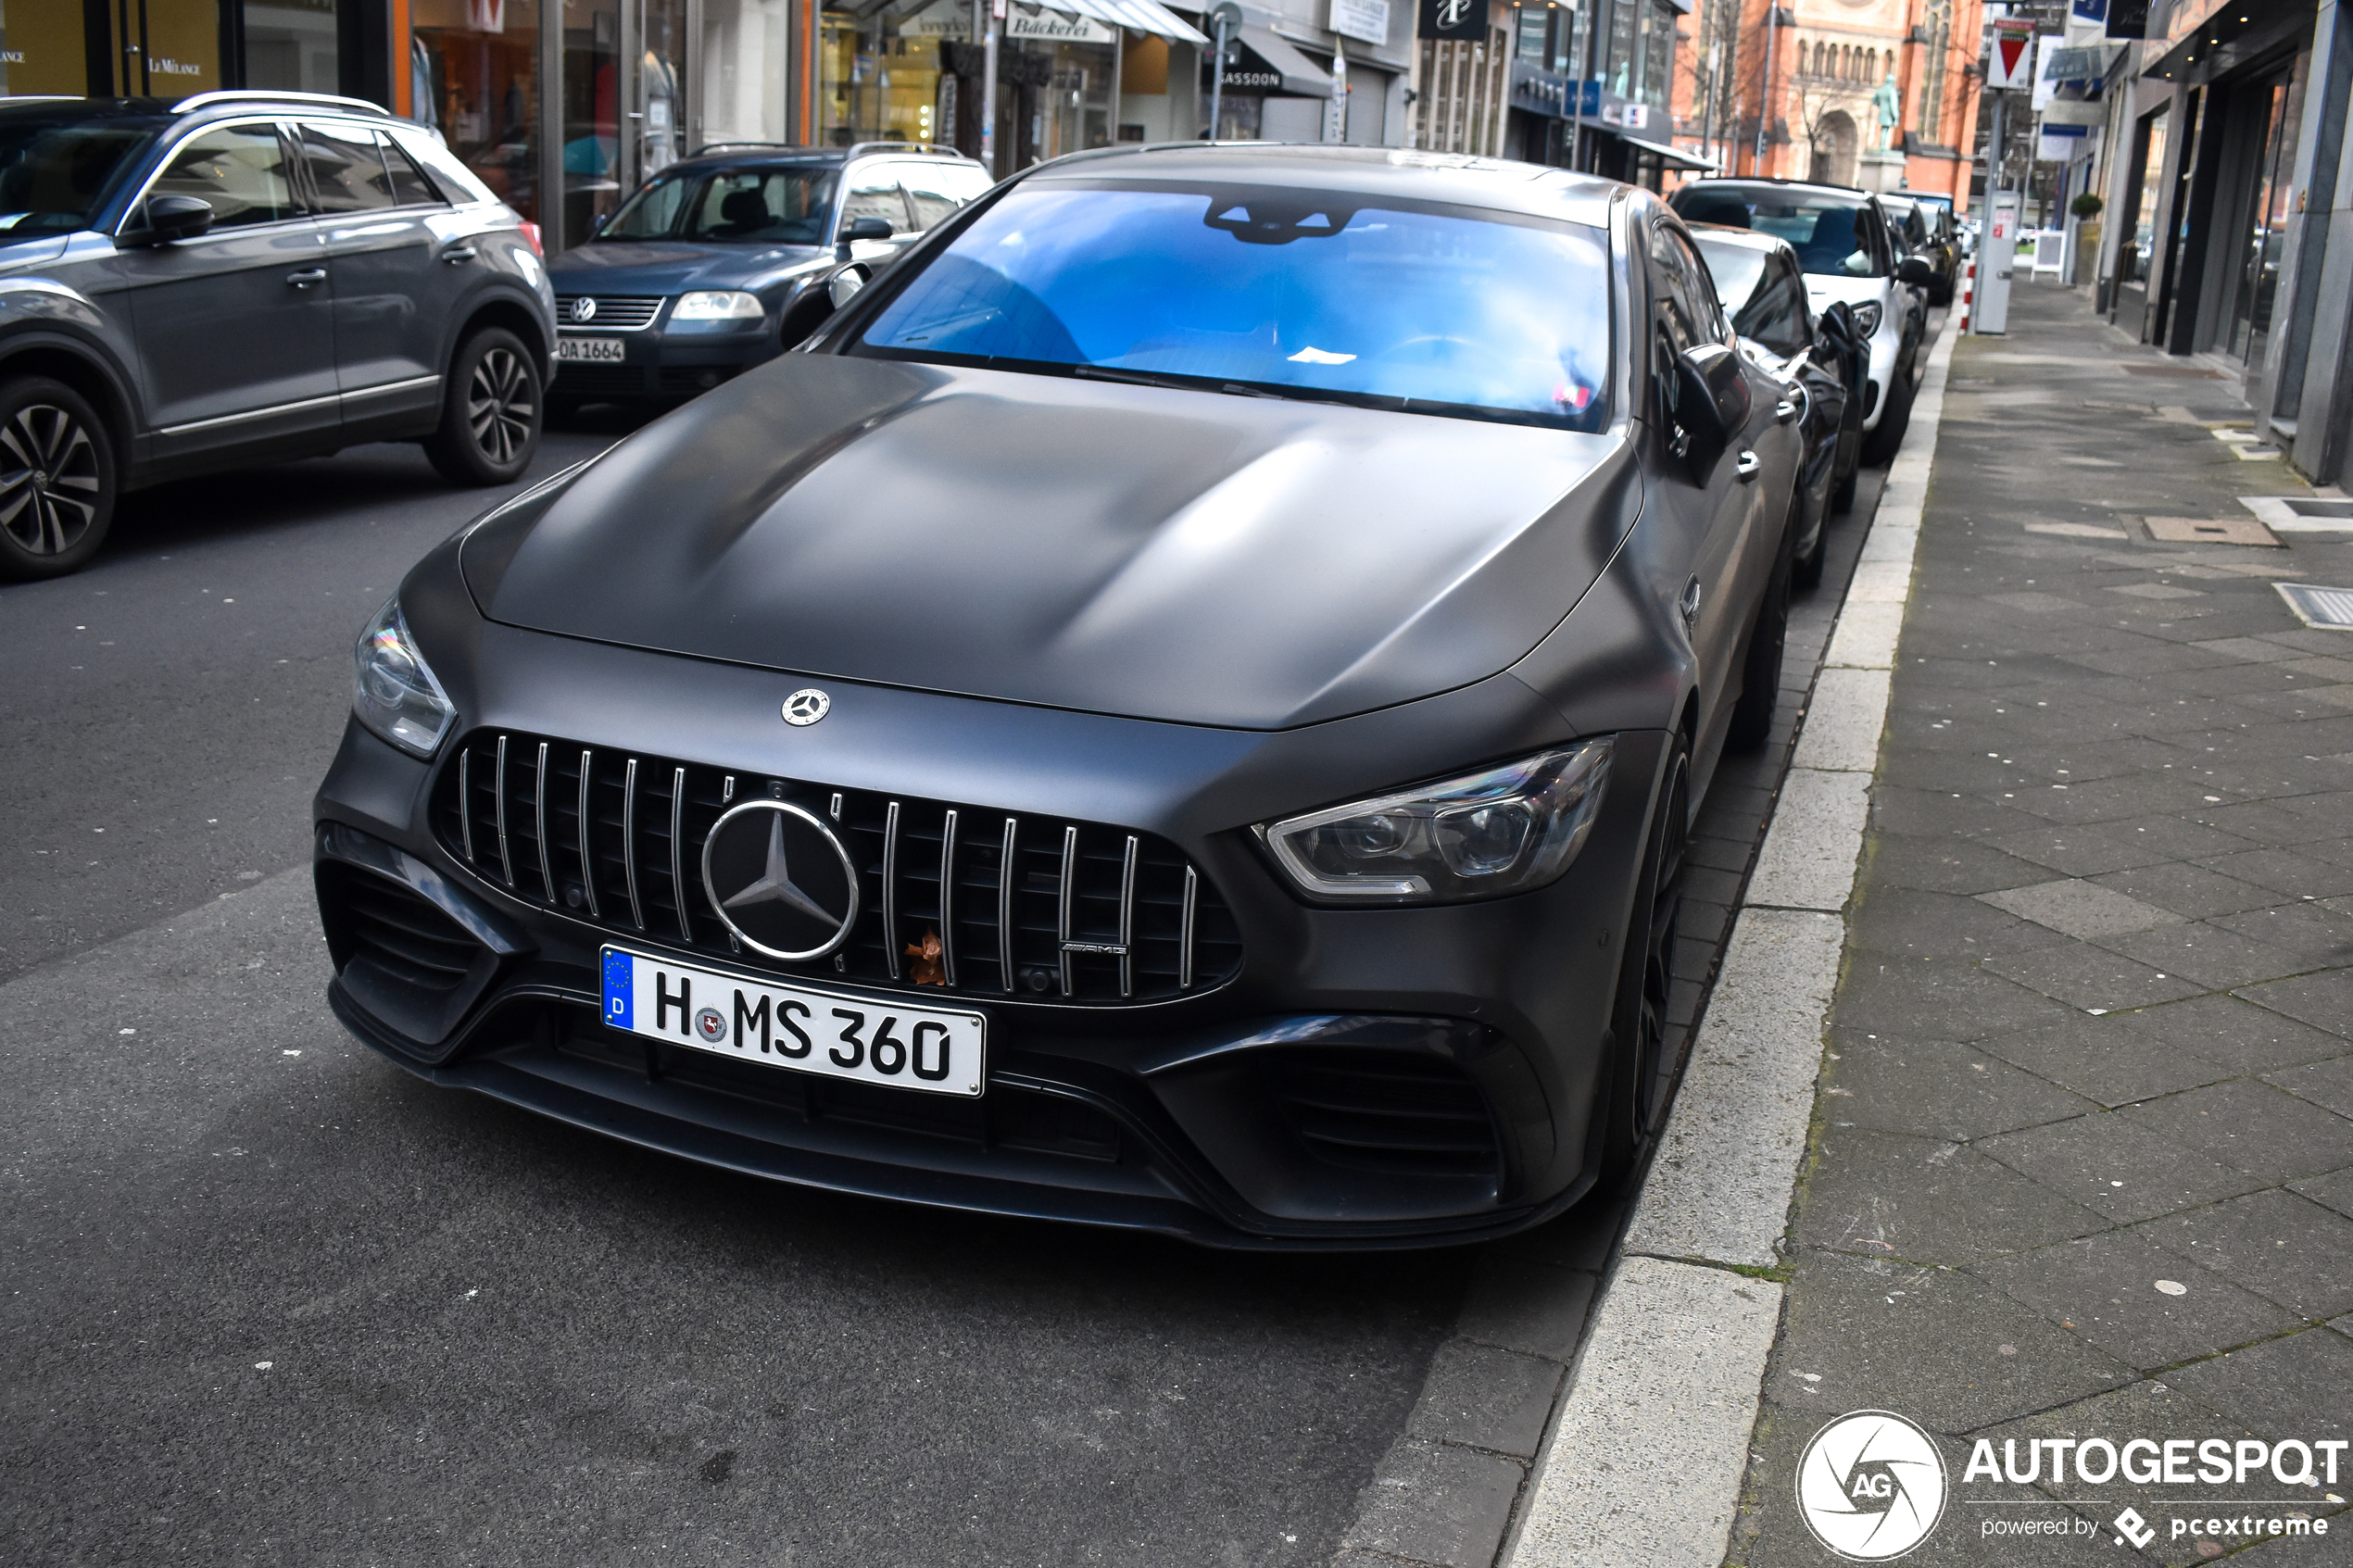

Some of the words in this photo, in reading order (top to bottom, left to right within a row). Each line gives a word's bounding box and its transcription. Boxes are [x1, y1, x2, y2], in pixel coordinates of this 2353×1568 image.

[582, 341, 622, 359] 1664
[611, 997, 624, 1015] D
[656, 971, 692, 1036] H
[733, 987, 812, 1060] MS
[827, 1007, 951, 1082] 360
